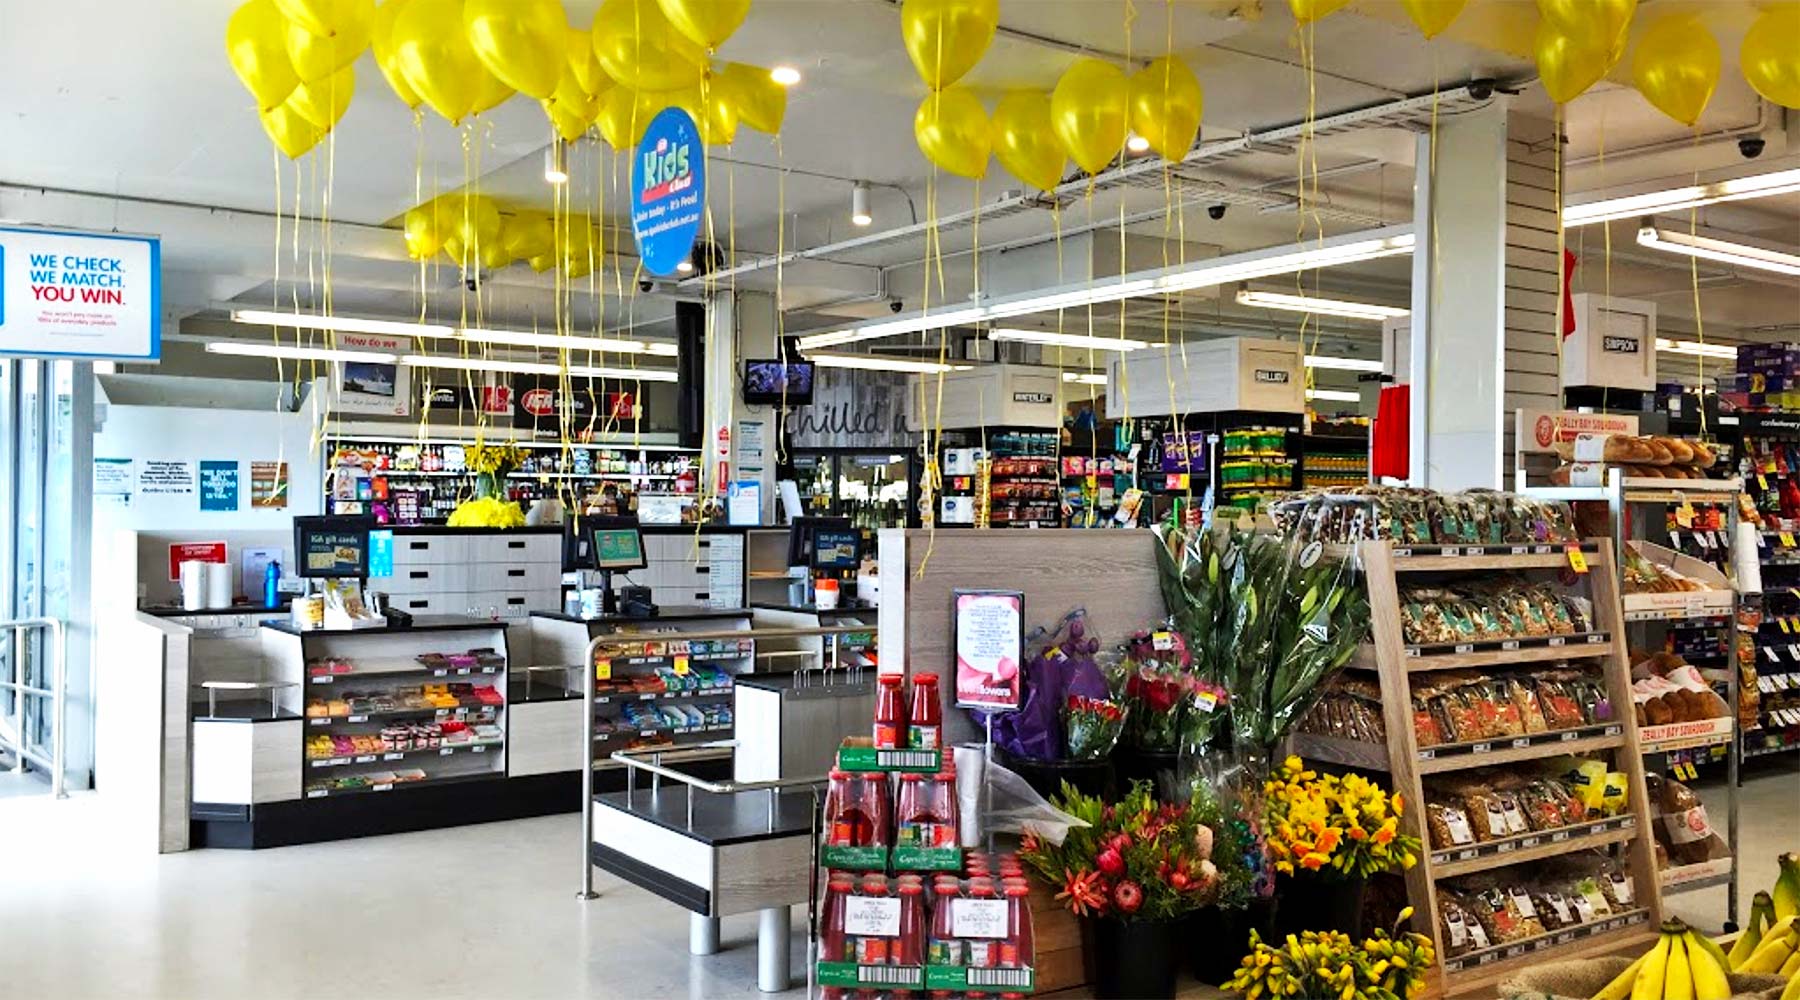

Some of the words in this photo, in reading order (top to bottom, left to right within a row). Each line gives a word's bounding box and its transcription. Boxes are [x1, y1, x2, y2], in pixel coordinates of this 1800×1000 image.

[644, 142, 690, 190] Kids
[30, 253, 57, 269] WE
[63, 255, 126, 273] CHECK.
[30, 270, 57, 286] WE
[63, 271, 126, 288] MATCH.
[31, 285, 75, 302] YOU
[80, 287, 126, 305] WIN.
[344, 335, 367, 346] How
